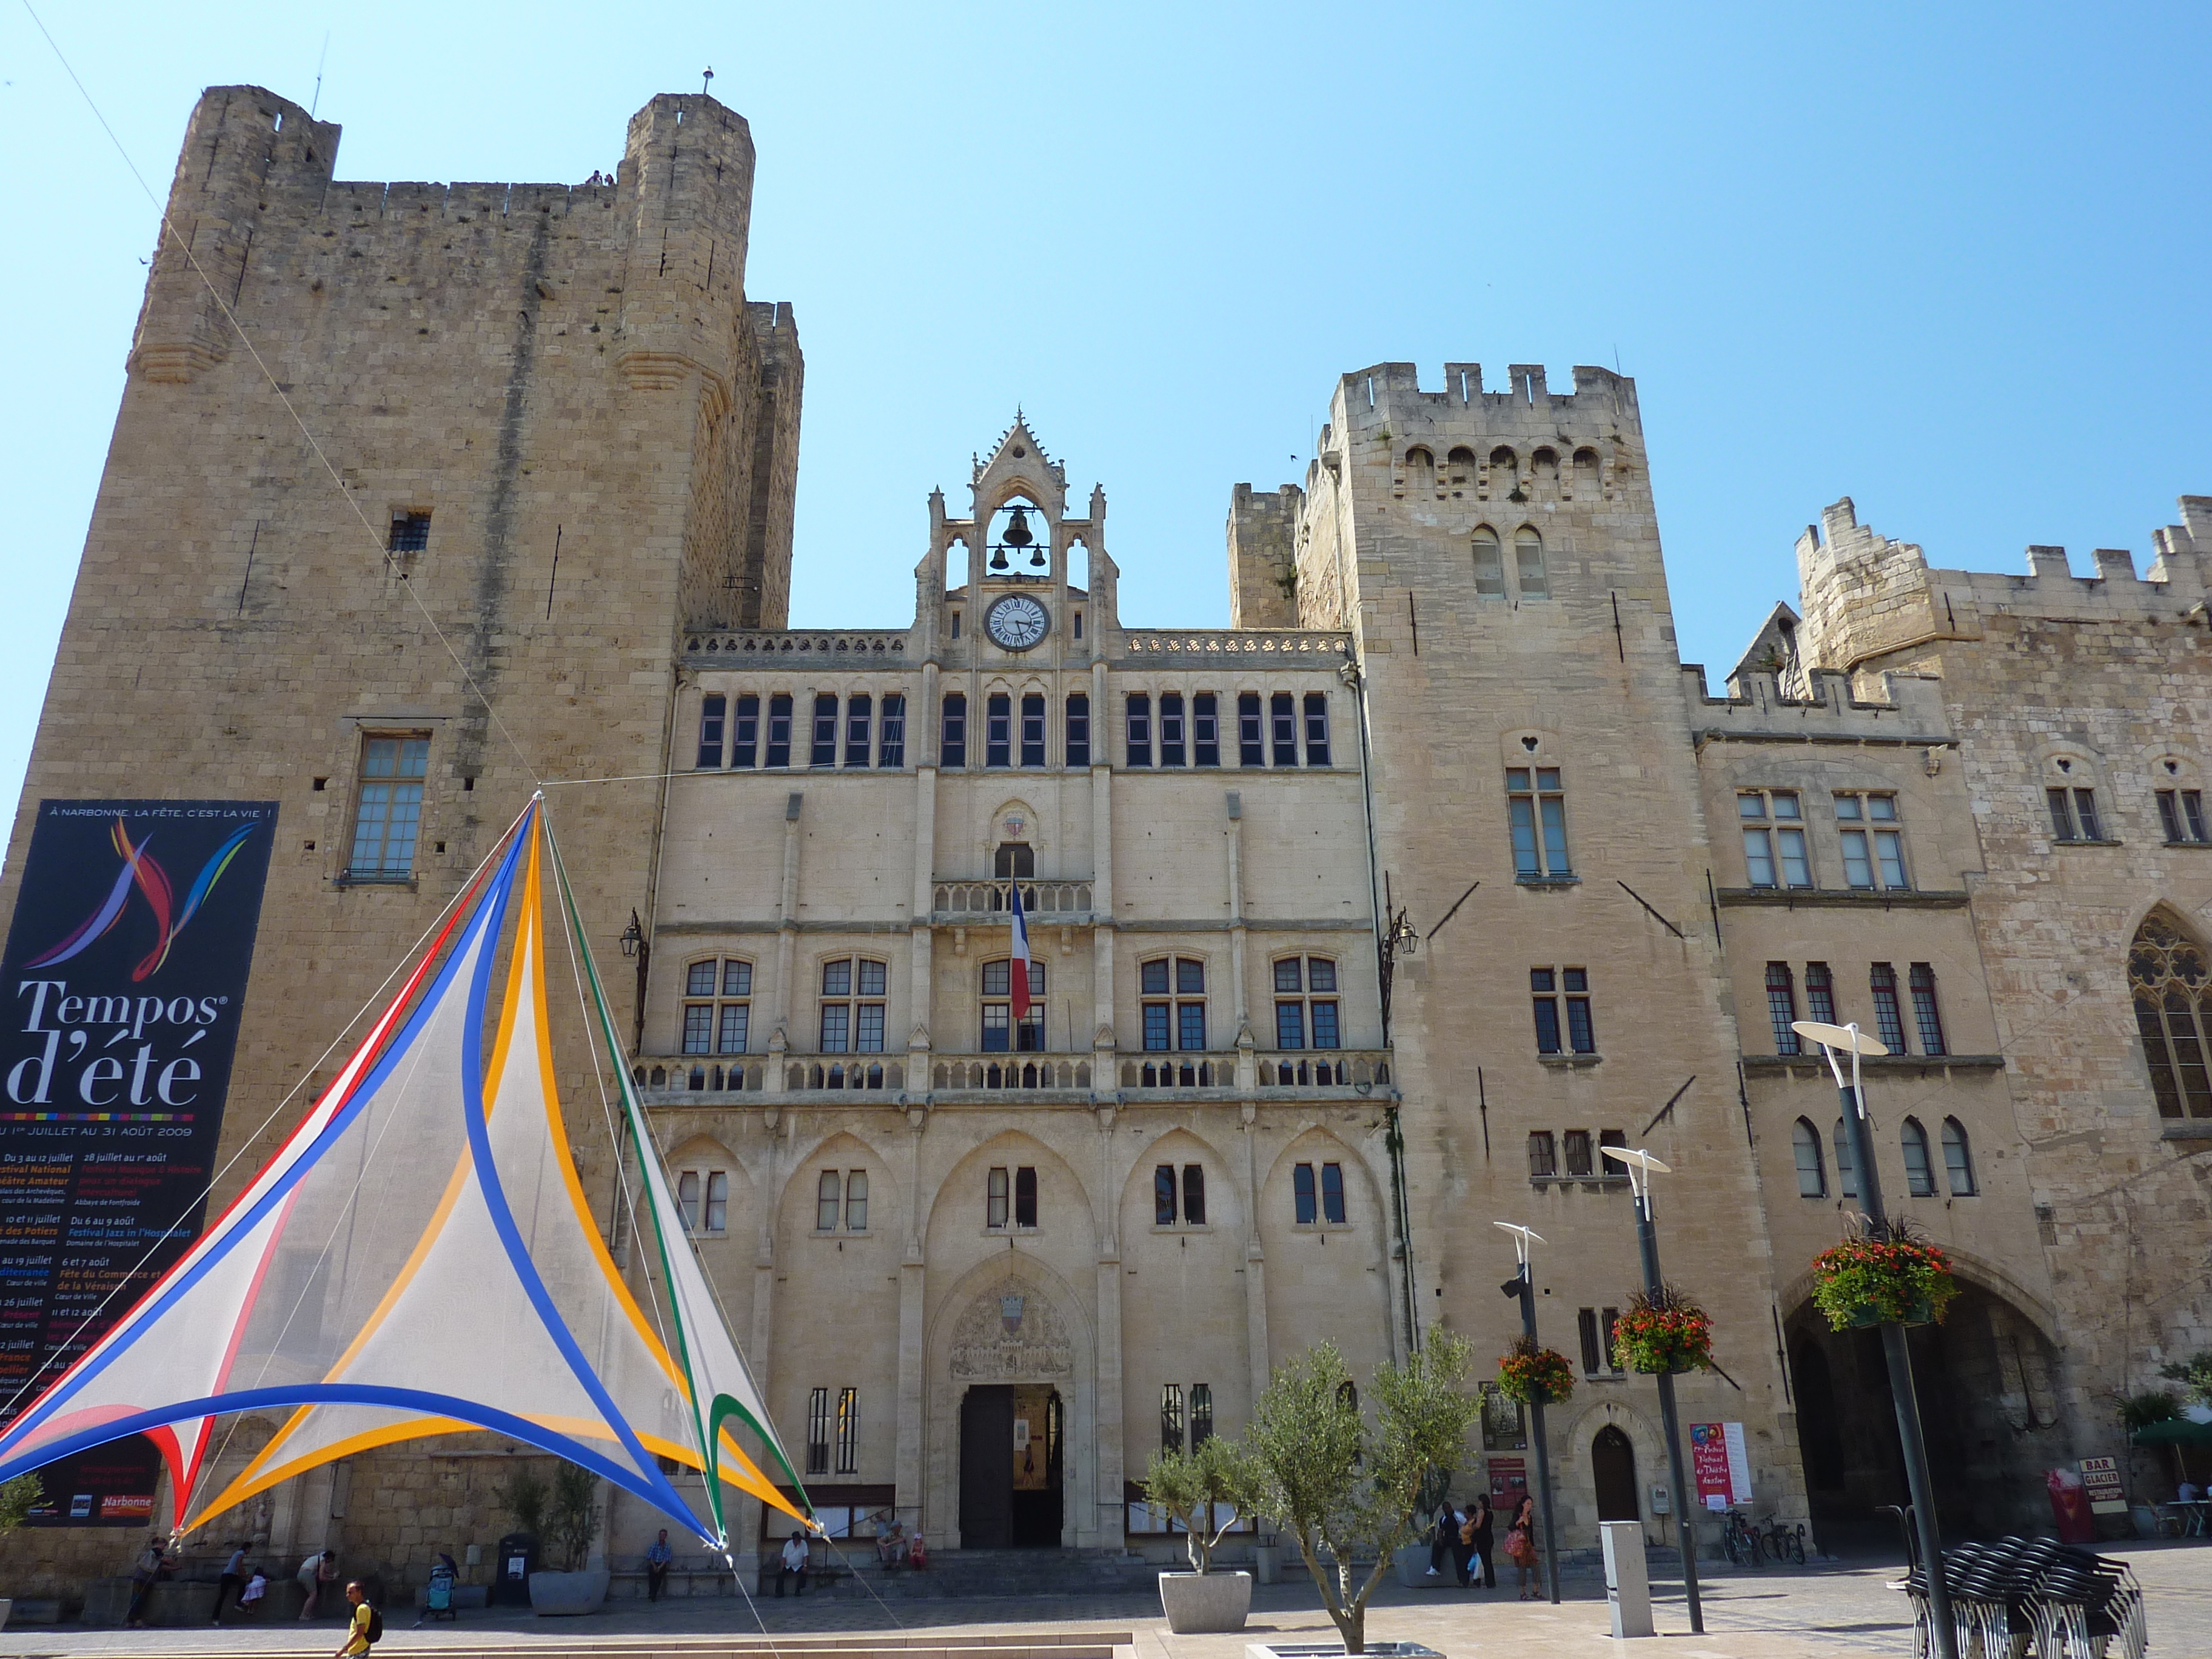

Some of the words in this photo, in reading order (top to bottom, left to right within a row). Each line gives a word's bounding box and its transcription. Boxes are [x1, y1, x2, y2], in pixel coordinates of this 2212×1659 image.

[49, 807, 58, 816] À
[187, 808, 221, 818] C'EST
[223, 809, 238, 818] LA
[241, 809, 260, 818] VIE
[7, 1029, 206, 1106] d'été
[0, 1127, 7, 1136] U
[28, 1127, 76, 1136] JUILLET
[81, 1127, 97, 1136] AU
[102, 1127, 116, 1136] 31
[121, 1126, 153, 1136] AOÛT
[157, 1128, 192, 1136] 2009
[18, 1155, 24, 1163] 3
[47, 1153, 74, 1164] juillet
[84, 1153, 95, 1161] 28
[96, 1152, 122, 1163] juillet
[146, 1153, 167, 1162] août
[0, 1164, 29, 1174] estival
[30, 1164, 72, 1174] National
[27, 1176, 70, 1185] Amateur
[35, 1214, 61, 1225] juillet
[70, 1216, 83, 1225] Du
[106, 1218, 113, 1227] 9
[113, 1215, 135, 1225] août
[5, 1226, 22, 1235] des
[24, 1226, 59, 1236] Potiers
[68, 1227, 104, 1237] Festival
[106, 1227, 125, 1238] Jazz
[127, 1227, 136, 1237] in
[15, 1257, 24, 1266] 19
[25, 1255, 53, 1267] juillet
[62, 1258, 69, 1266] 6
[70, 1258, 79, 1266] et
[81, 1259, 88, 1267] 7
[89, 1257, 110, 1267] août
[0, 1267, 50, 1276] diterranée
[59, 1269, 81, 1278] Fête
[82, 1269, 95, 1278] du
[150, 1270, 162, 1279] et
[57, 1281, 70, 1291] de
[72, 1281, 82, 1291] la
[4, 1298, 15, 1307] 26
[16, 1296, 44, 1309] juillet
[7, 1339, 35, 1351] juillet
[2086, 1459, 2110, 1470] BAR
[2085, 1473, 2119, 1484] GLACIER
[102, 1495, 152, 1507] Narbonne
